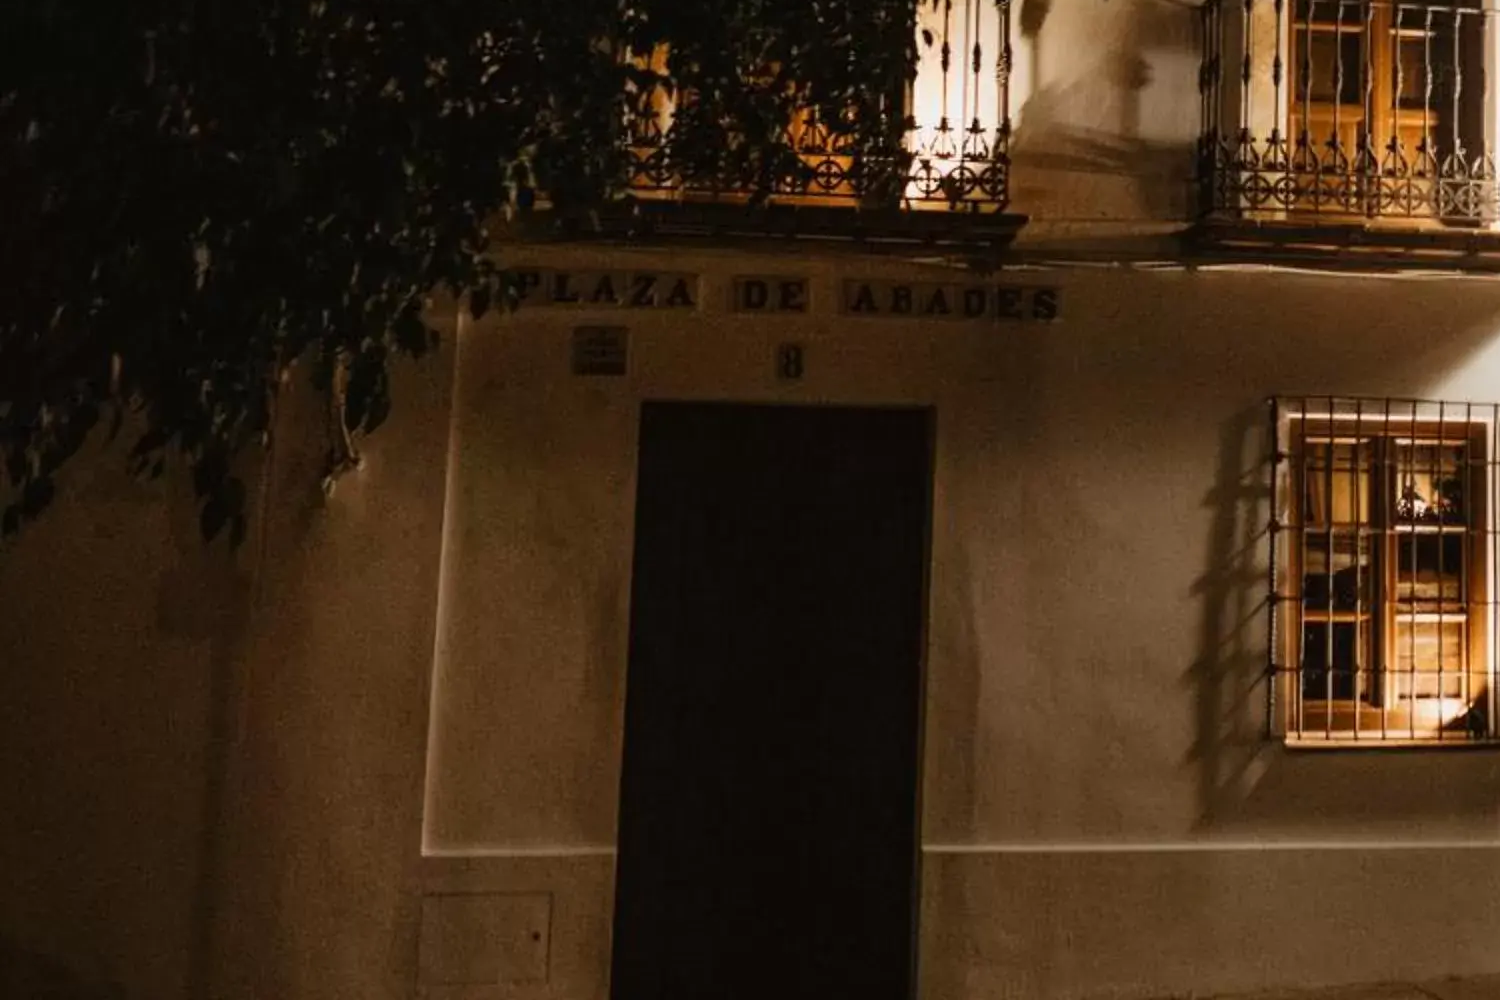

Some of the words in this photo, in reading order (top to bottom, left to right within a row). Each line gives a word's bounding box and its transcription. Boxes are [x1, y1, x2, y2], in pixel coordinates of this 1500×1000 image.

[742, 279, 805, 312] DE
[849, 284, 1058, 320] ABADES
[781, 345, 803, 378] 8
